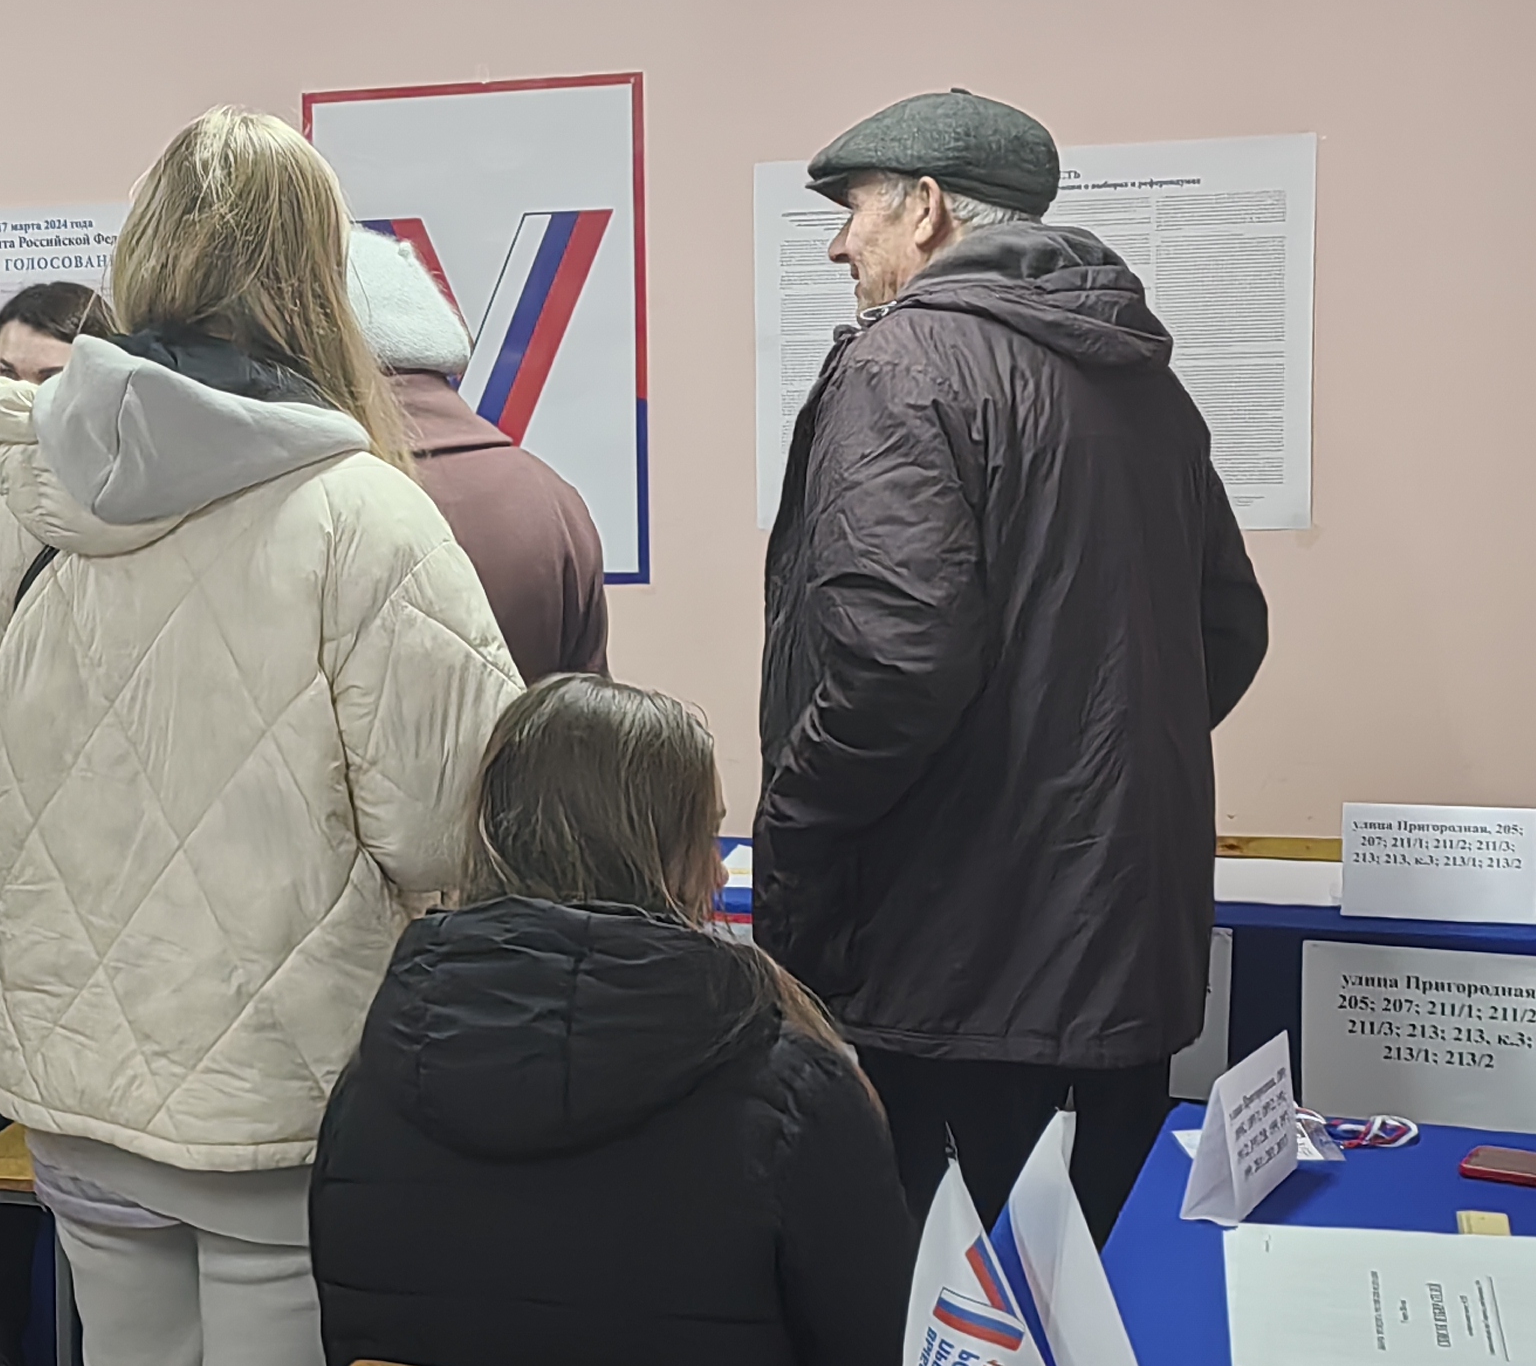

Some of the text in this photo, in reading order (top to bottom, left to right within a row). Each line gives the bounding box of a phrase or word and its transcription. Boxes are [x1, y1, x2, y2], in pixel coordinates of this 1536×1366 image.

[10, 221, 42, 234] марта
[44, 219, 68, 230] 2024
[70, 219, 94, 230] года
[18, 233, 91, 249] Российской
[94, 234, 118, 246] Фед
[1352, 820, 1524, 837] улица Пригородная, 205;
[1361, 835, 1516, 853] 207; 211/1; 211/2; 211/3;
[1352, 852, 1381, 865] 213;
[1444, 855, 1483, 869] 213/1;
[1487, 856, 1522, 870] 213/2
[1341, 974, 1536, 999] улица Пригородная
[1338, 993, 1376, 1012] 205;
[1381, 997, 1421, 1016] 207;
[1426, 1000, 1483, 1020] 211/1;
[1347, 1019, 1402, 1038] 211/3;
[1406, 1023, 1446, 1042] 213;
[1382, 1045, 1495, 1069] 213/1; 213/2
